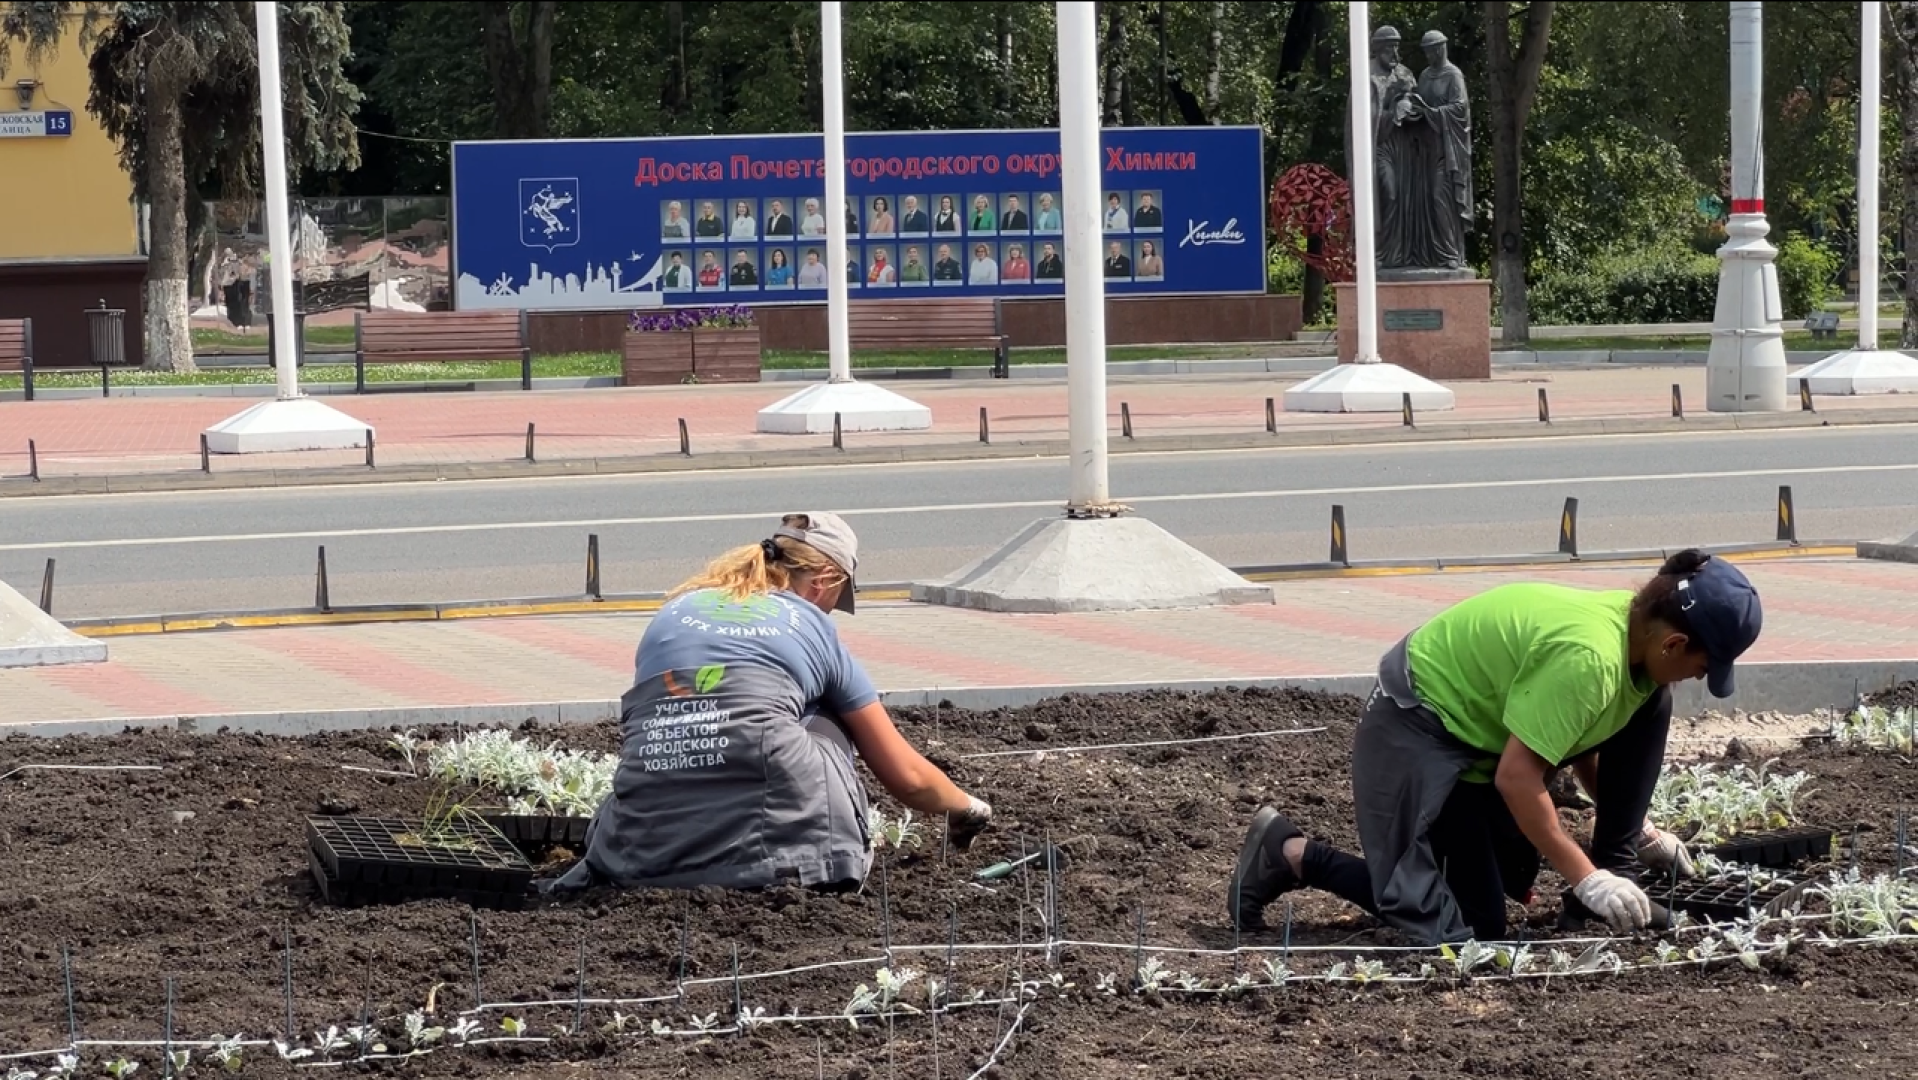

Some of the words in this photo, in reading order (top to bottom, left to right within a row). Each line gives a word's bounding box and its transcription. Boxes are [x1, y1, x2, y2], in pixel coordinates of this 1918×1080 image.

[1, 126, 32, 135] ЛИЦА
[50, 117, 67, 130] 15
[634, 157, 724, 188] Доска
[1005, 152, 1062, 179] окр
[1105, 146, 1197, 172] Химки
[1178, 217, 1247, 249] Химки
[680, 615, 712, 632] ОГХ
[715, 625, 782, 637] ХИМКИ
[655, 698, 719, 717] УЧАСТОК
[641, 711, 730, 731] СОДЕРЖАНИЯ
[646, 722, 719, 742] ОБЪЕКТОВ
[639, 736, 730, 757] ГОРОДСКОГО
[643, 752, 727, 772] ХОЗЯЙСТВА
